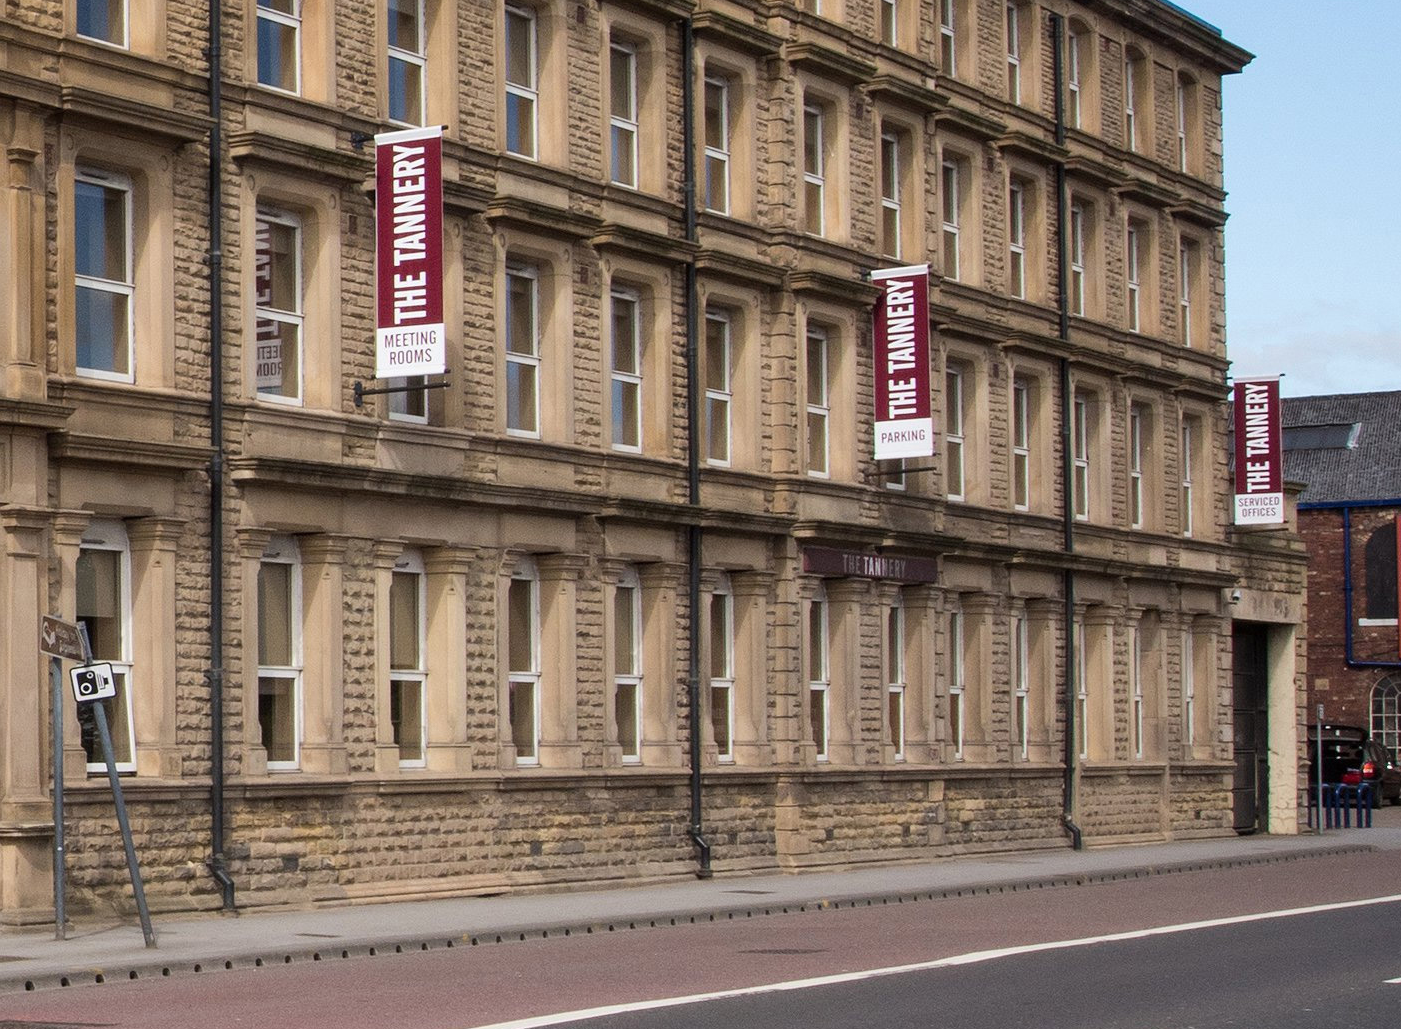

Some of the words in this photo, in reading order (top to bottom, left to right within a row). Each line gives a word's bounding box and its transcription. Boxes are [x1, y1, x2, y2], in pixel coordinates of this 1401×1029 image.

[393, 145, 426, 267] TANNERY
[394, 271, 427, 325] THE
[384, 330, 437, 349] MEETING
[886, 279, 916, 374] TANNERY
[389, 348, 432, 366] ROOMS
[889, 377, 917, 420] THE
[1245, 383, 1269, 457] TANNERY
[880, 429, 926, 443] PARKING
[1246, 461, 1270, 493] THE
[1238, 496, 1280, 507] SERVICED
[1242, 507, 1276, 517] OFFICES
[842, 554, 860, 574] THE
[863, 555, 907, 578] TANNERY
